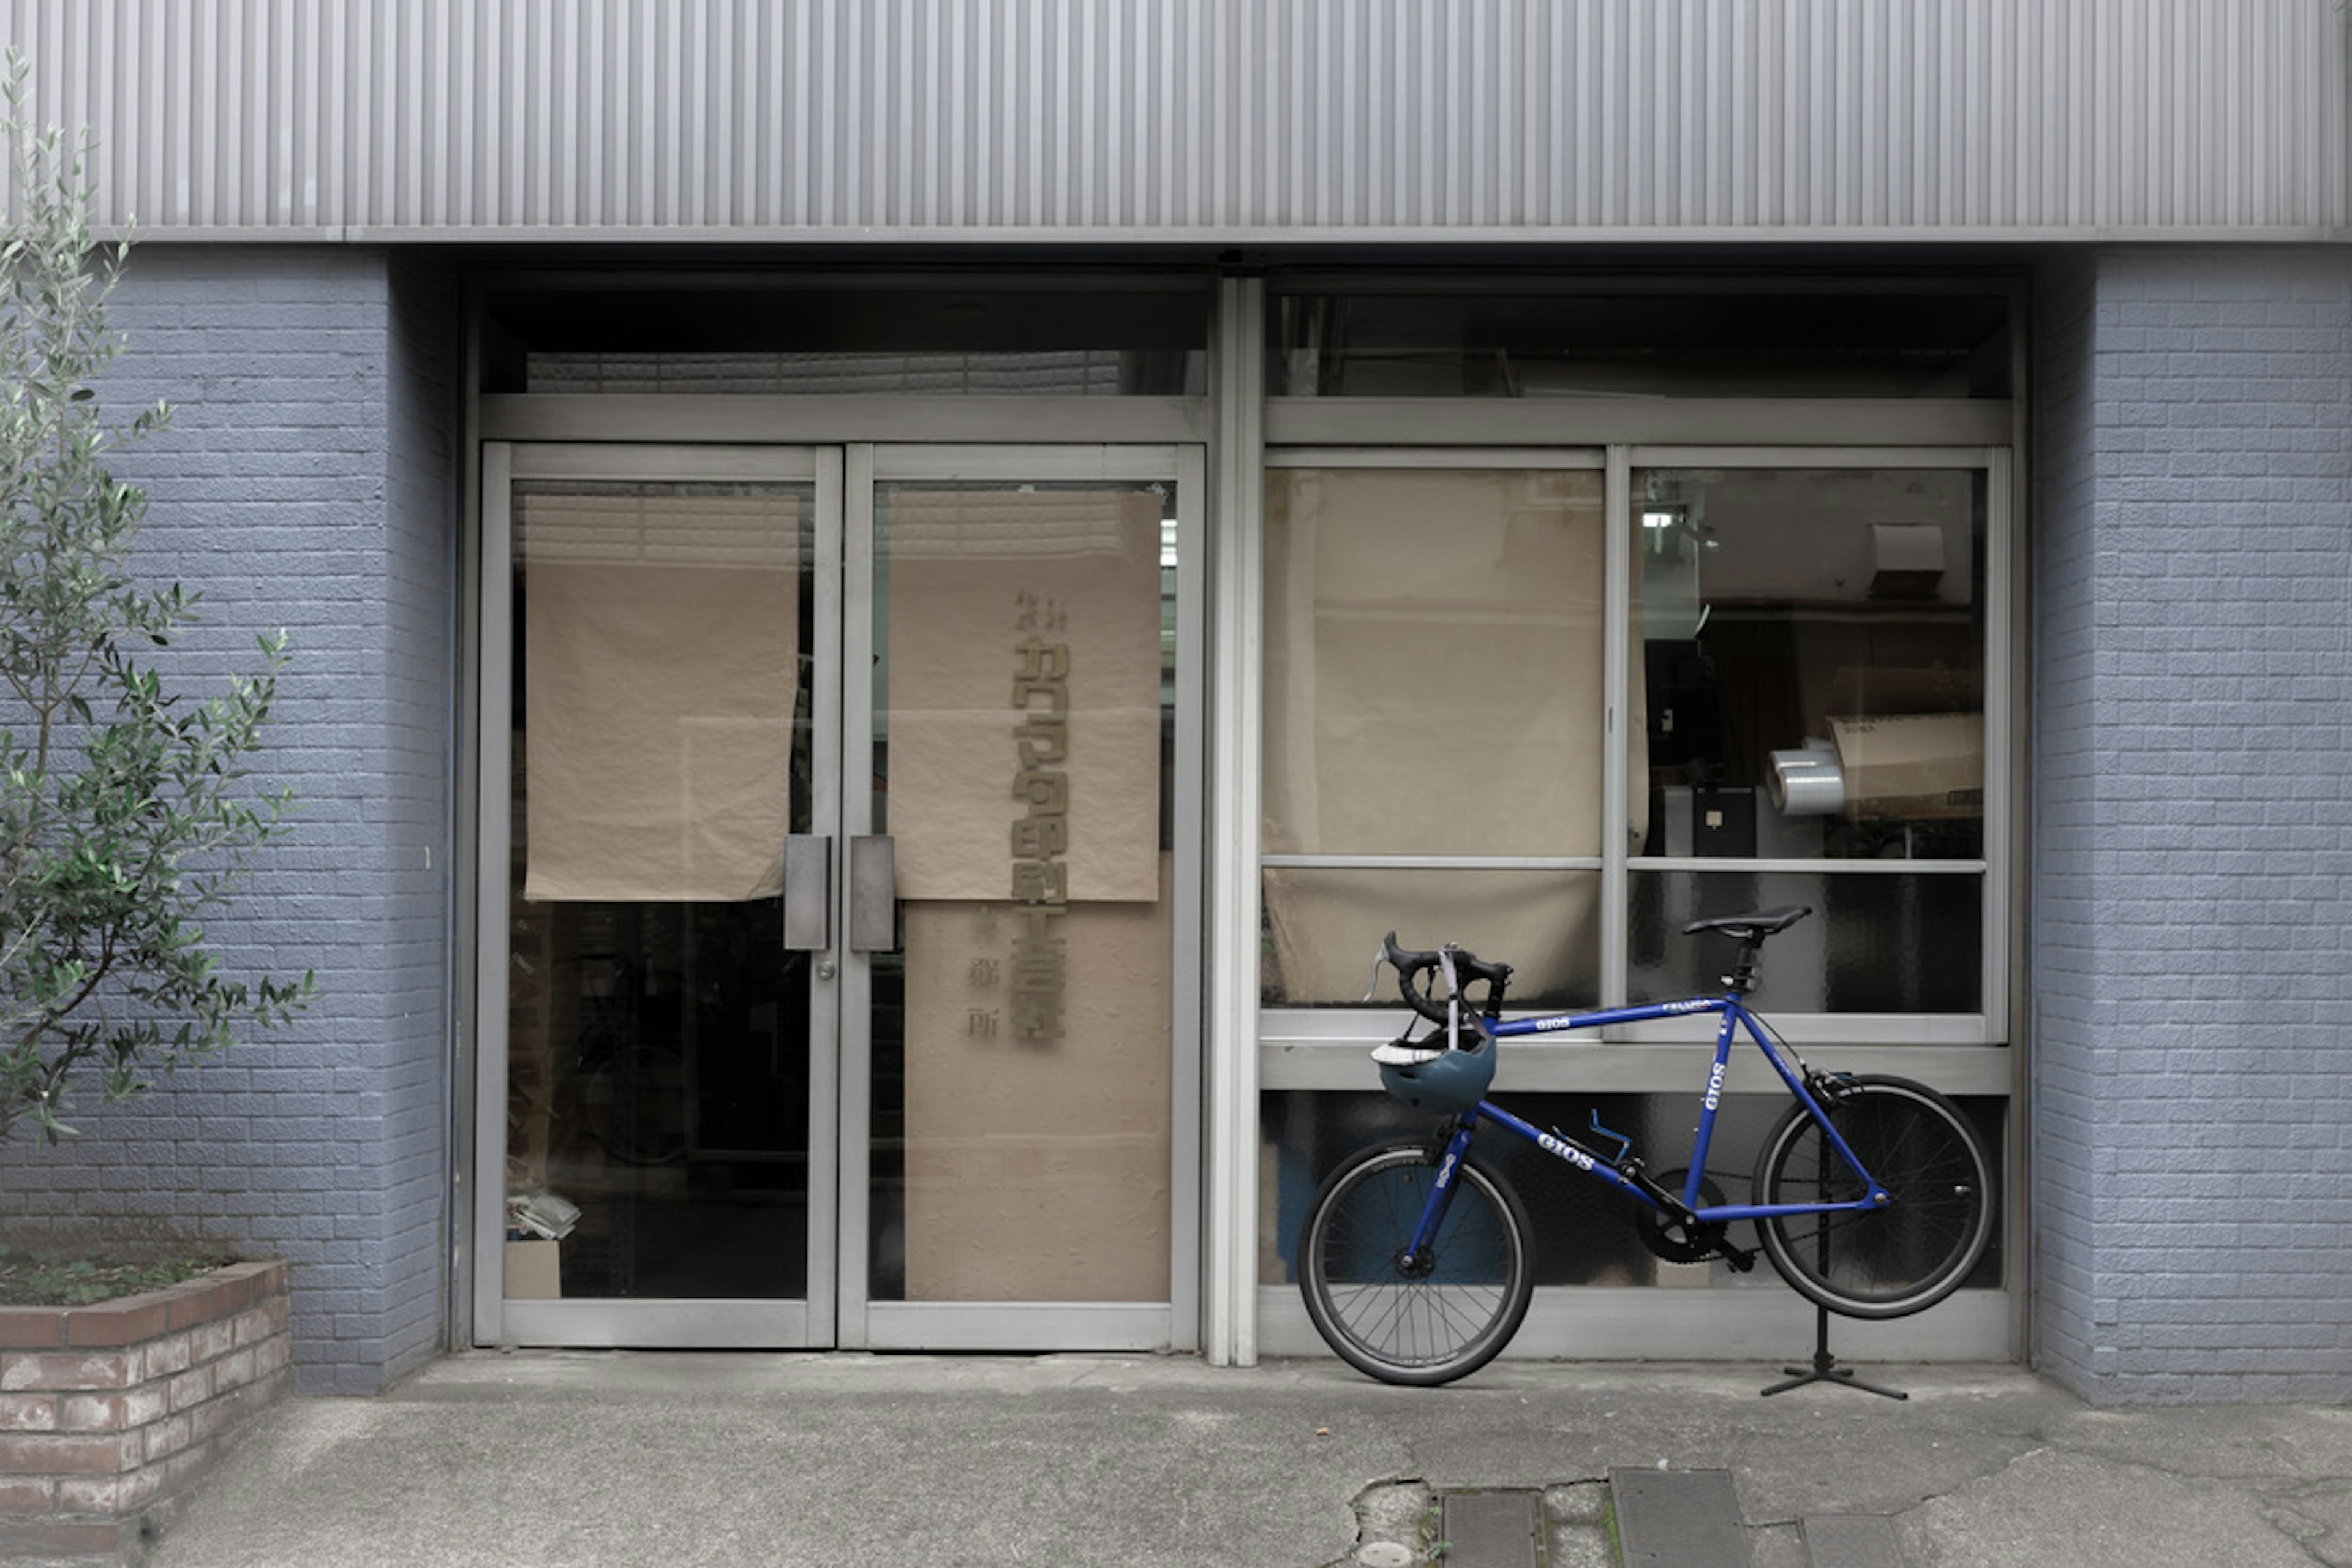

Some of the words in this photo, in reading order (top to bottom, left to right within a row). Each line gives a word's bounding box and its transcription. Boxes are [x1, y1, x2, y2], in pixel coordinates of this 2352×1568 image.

[1536, 1016, 1570, 1031] GIOS
[1705, 1063, 1726, 1110] GIOS
[1537, 1133, 1595, 1171] GIOS
